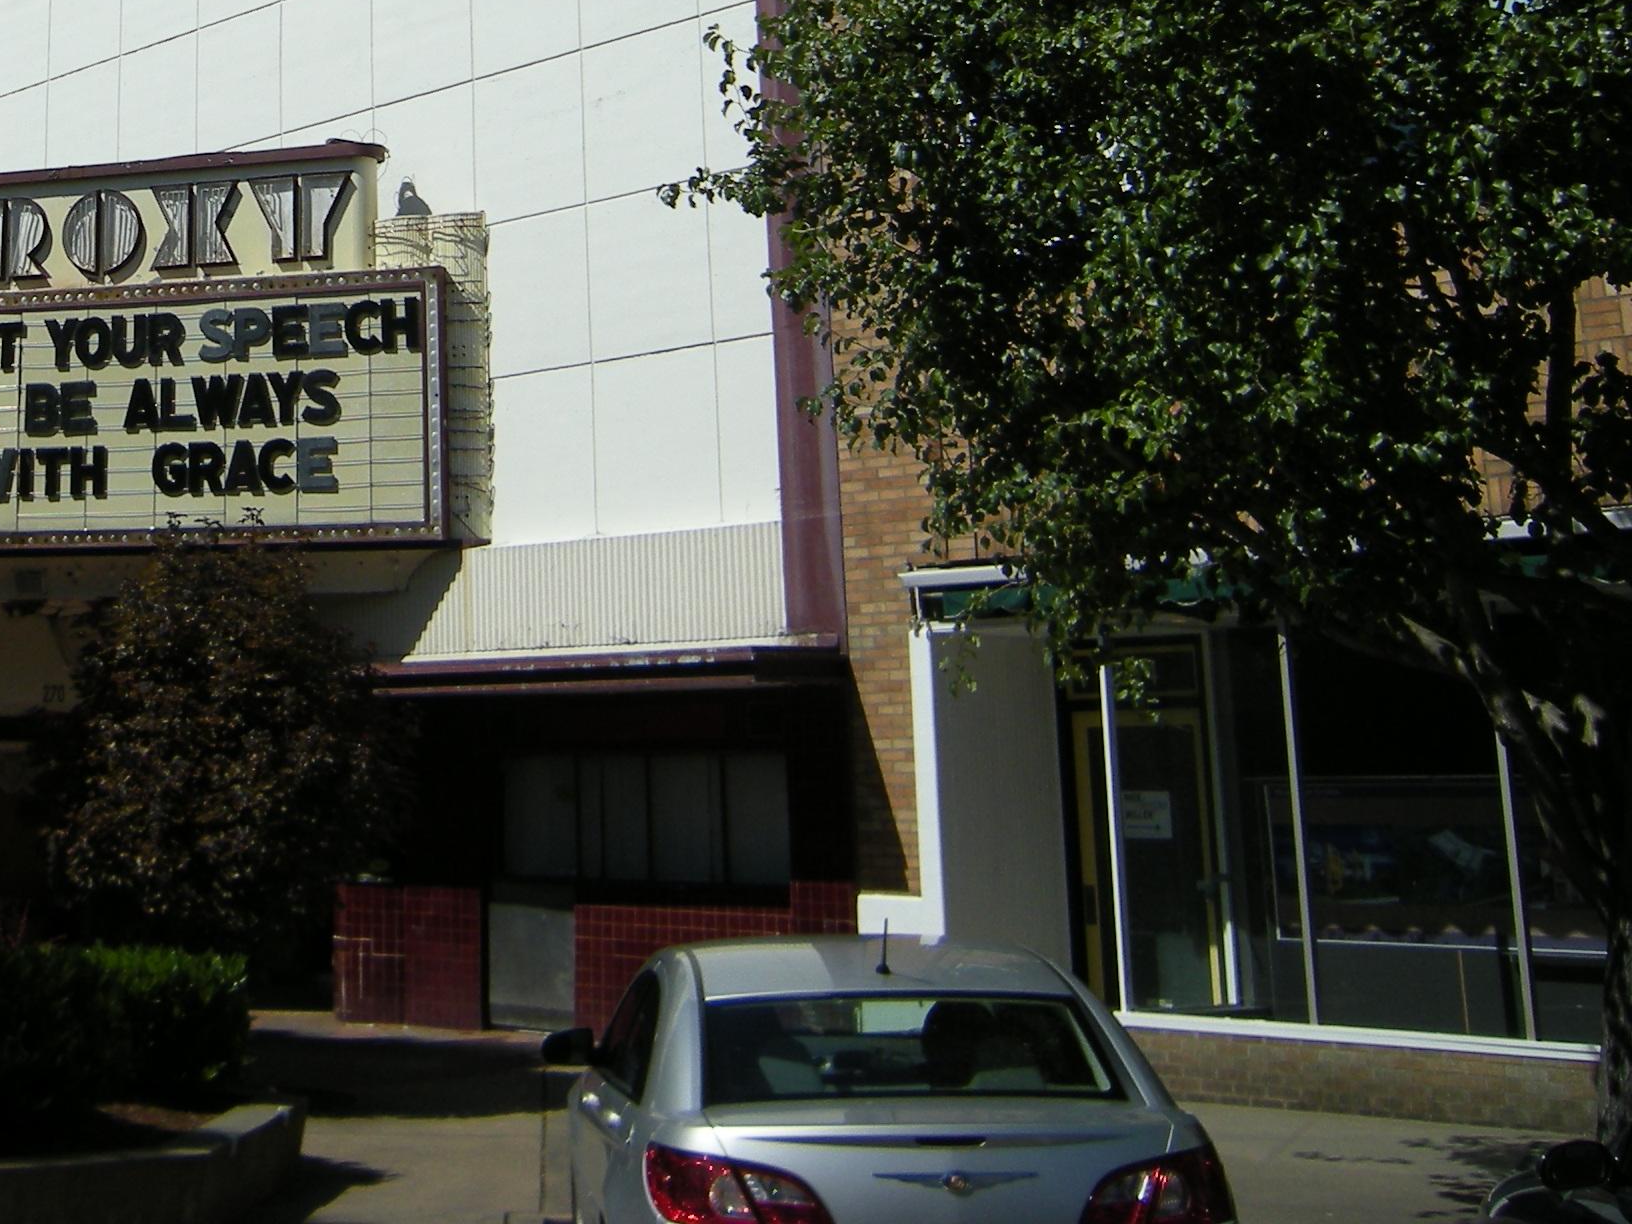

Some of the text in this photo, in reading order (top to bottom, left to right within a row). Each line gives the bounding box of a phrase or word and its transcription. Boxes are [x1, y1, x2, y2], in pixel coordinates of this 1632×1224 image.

[45, 311, 186, 373] YOUR
[198, 296, 422, 364] SPEECH
[25, 368, 342, 437] BE ALWAYS
[152, 436, 339, 498] GRACE
